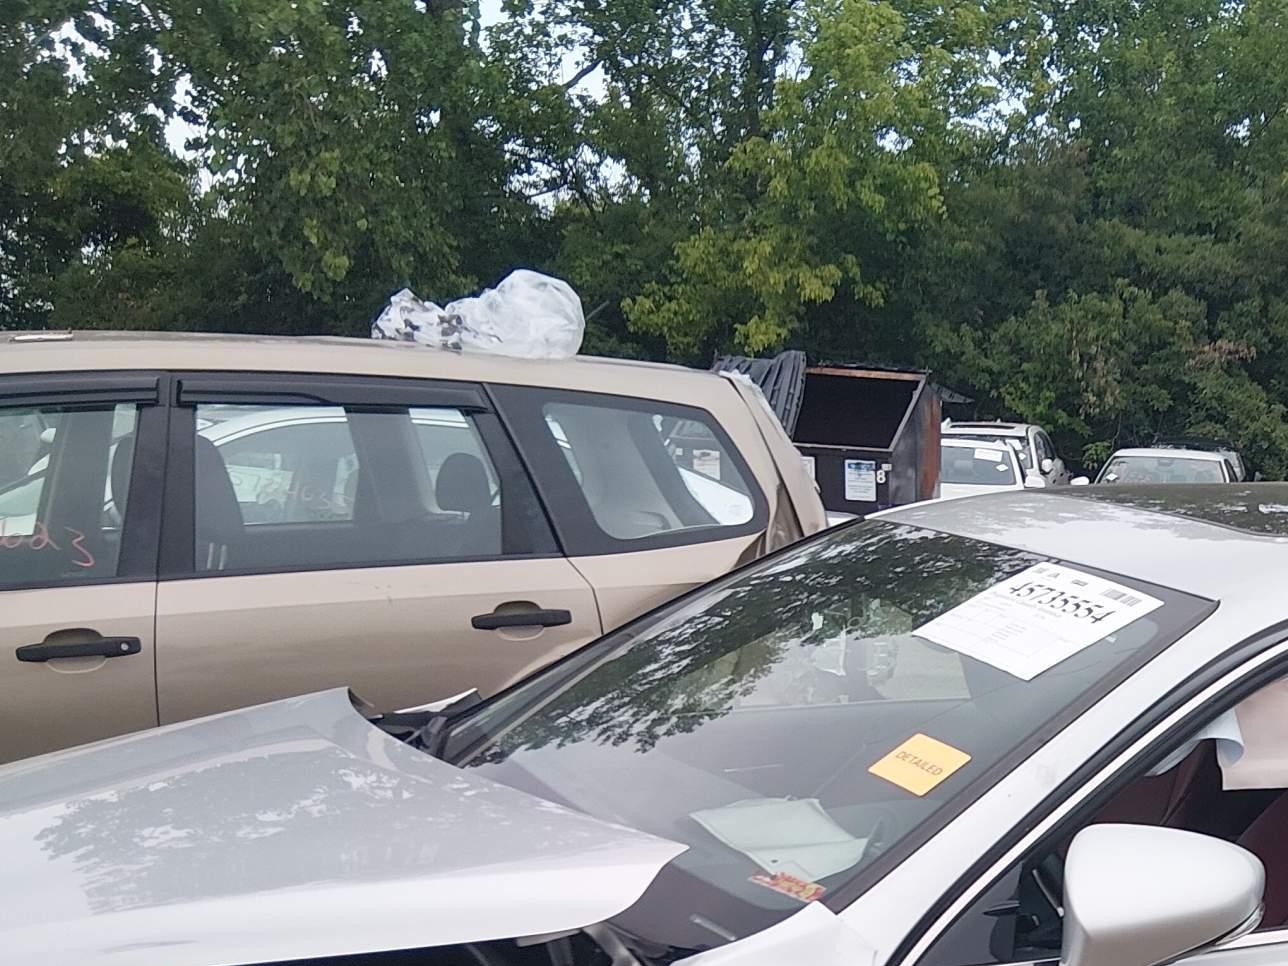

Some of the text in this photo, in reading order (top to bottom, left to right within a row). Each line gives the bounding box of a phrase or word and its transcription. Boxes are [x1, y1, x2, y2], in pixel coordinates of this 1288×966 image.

[876, 470, 886, 484] 8
[1009, 581, 1116, 624] 45735554
[895, 751, 944, 776] DETAILED
